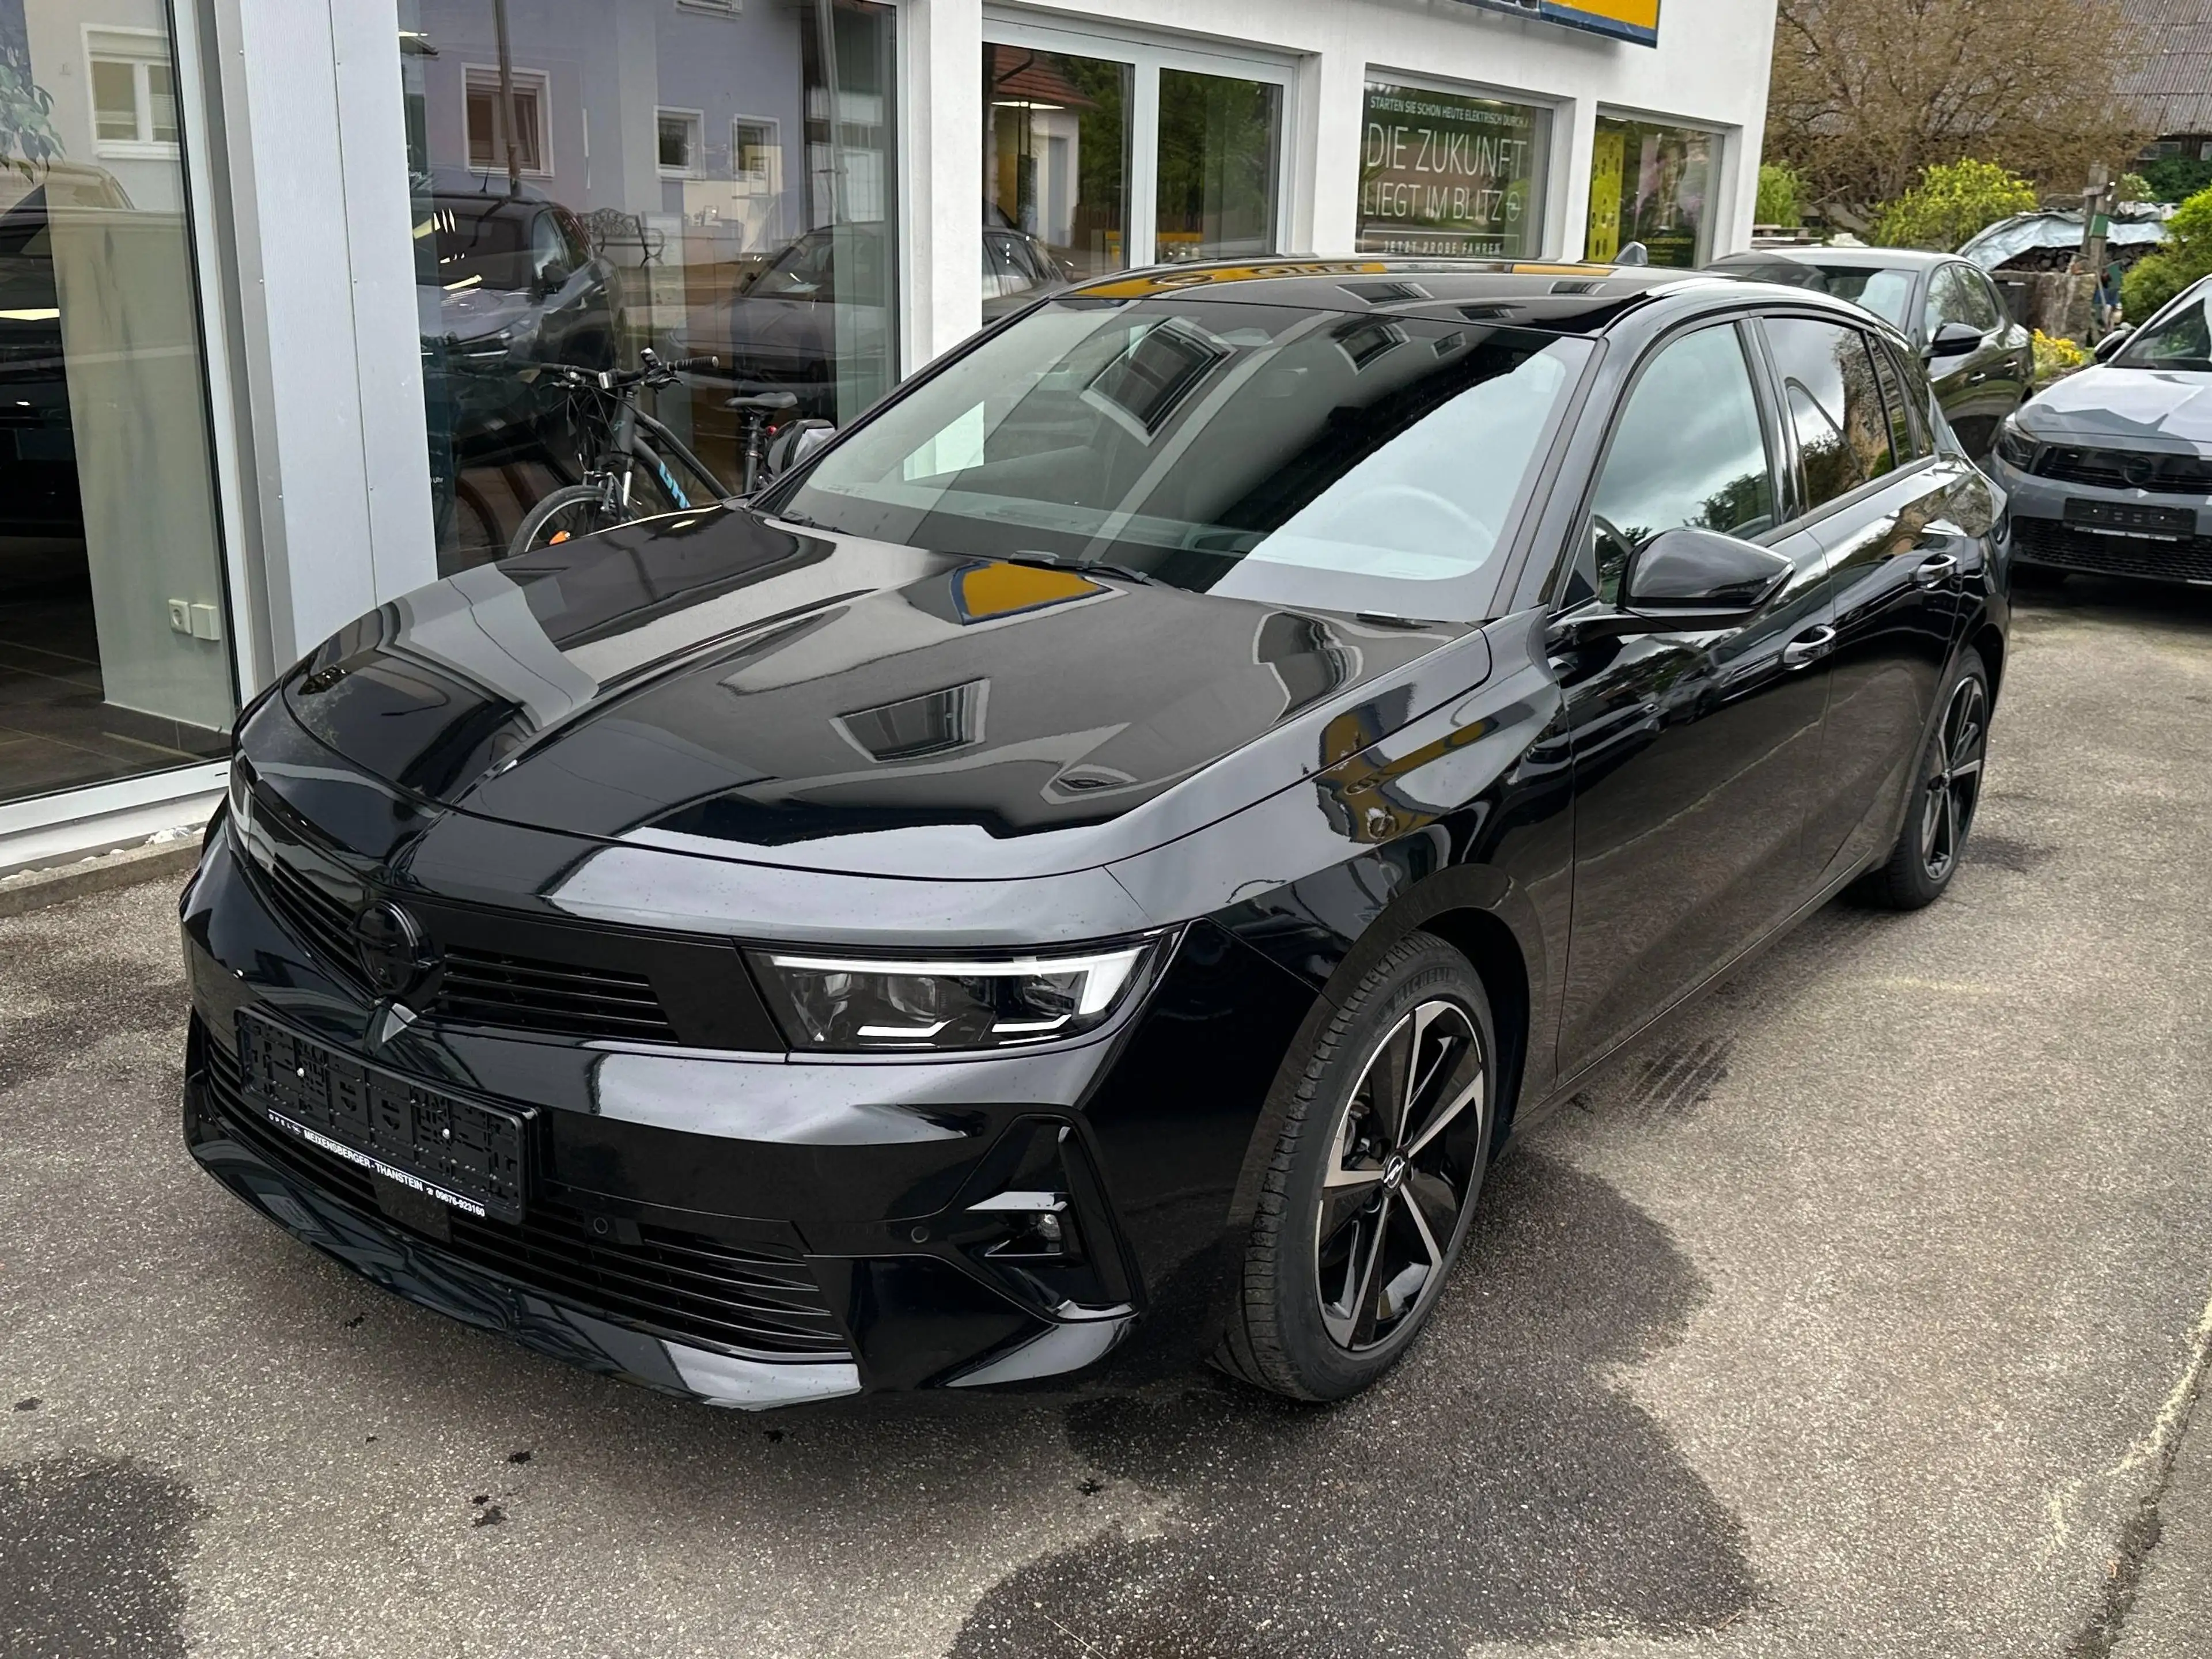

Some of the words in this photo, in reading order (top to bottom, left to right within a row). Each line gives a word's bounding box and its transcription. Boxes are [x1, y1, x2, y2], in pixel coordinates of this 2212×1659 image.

[1370, 96, 1404, 112] STARTEN
[1405, 101, 1416, 113] SIE
[1417, 102, 1441, 116] SCHON
[1442, 106, 1464, 120] HEUTE
[1465, 109, 1502, 125] ELEKTRISCH
[1366, 122, 1409, 169] DIE
[1415, 128, 1528, 179] ZUKUNFT
[1363, 181, 1422, 217] LIEGT
[1425, 185, 1448, 221] IM
[1452, 187, 1504, 221] BLITZ
[1383, 241, 1417, 253] JETZT
[1422, 241, 1458, 255] PROBE
